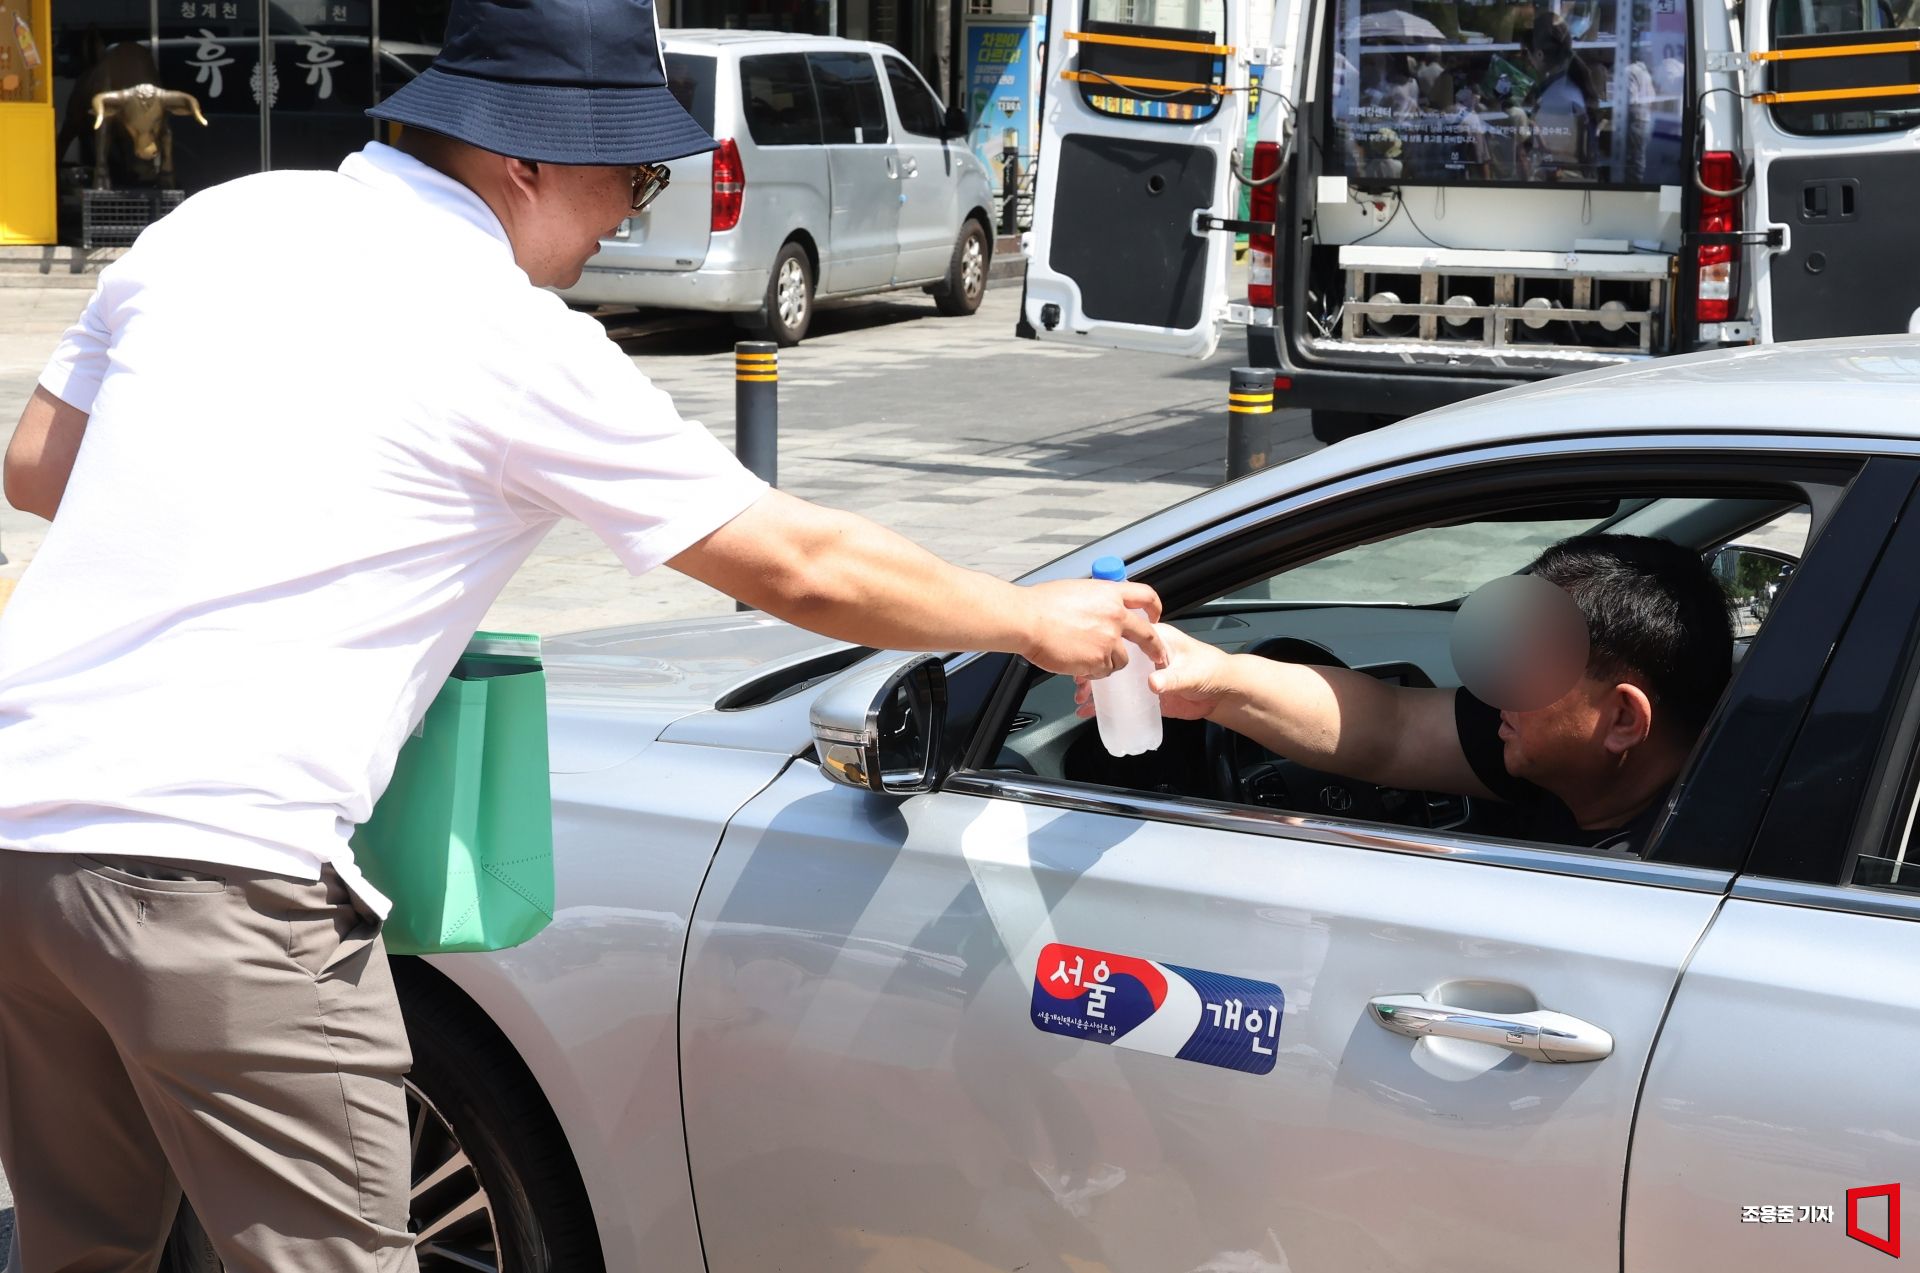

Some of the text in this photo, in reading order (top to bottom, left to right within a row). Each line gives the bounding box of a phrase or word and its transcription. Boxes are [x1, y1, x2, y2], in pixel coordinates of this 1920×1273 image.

[181, 2, 237, 19] 청계천
[184, 28, 235, 98] 휴
[295, 31, 344, 99] 휴
[998, 101, 1021, 111] TERRA
[1050, 955, 1115, 1018] 서울
[1037, 1011, 1116, 1037] 서울개인택시운송사업조합
[1206, 998, 1277, 1056] 개인
